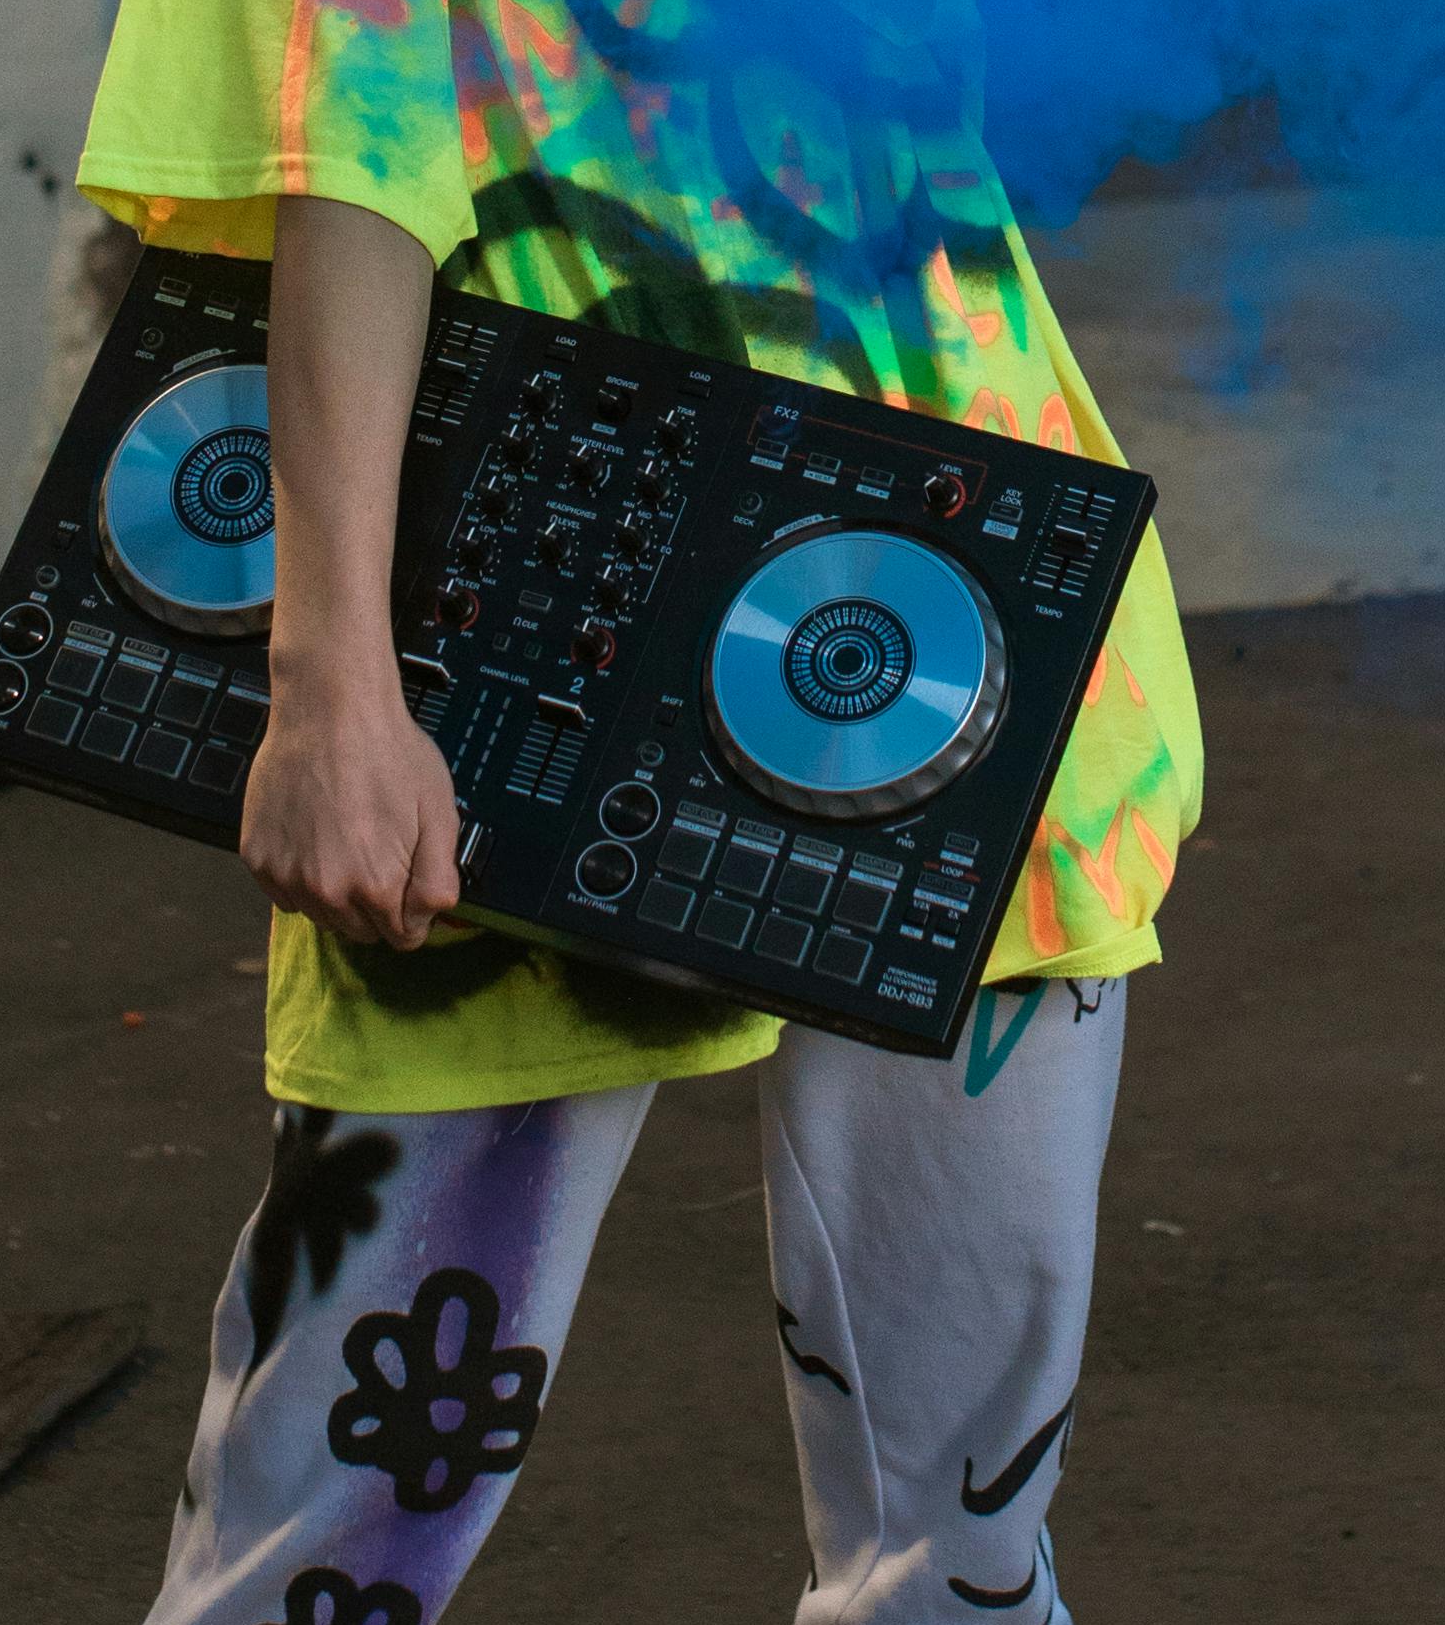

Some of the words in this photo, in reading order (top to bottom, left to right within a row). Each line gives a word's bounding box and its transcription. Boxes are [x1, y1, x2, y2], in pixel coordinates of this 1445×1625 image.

[555, 335, 577, 347] LOAD
[135, 349, 155, 361] DECK
[543, 370, 562, 381] TRIM
[689, 370, 711, 382] LOAD
[605, 376, 640, 391] BROWSE
[677, 405, 697, 417] TRIM
[773, 405, 800, 421] FX2
[415, 432, 443, 447] TEMPO
[571, 435, 601, 450] MASTER
[602, 443, 625, 456] LEVEL
[940, 463, 964, 476] LEVEL
[502, 473, 518, 483] MID
[462, 491, 474, 500] EQ
[1005, 488, 1023, 498] KEY
[1000, 495, 1022, 506] LOCK
[546, 500, 598, 520] HEADPHONES
[637, 510, 653, 520] MID
[58, 520, 81, 533] SHIFT
[558, 518, 581, 530] LEVEL
[733, 515, 754, 527] DECK
[479, 525, 498, 535] LOW
[660, 545, 672, 555] EQ
[615, 562, 634, 572] LOW
[455, 577, 481, 591] FILTER
[81, 598, 98, 609] REV
[1035, 604, 1063, 619] TEMPO
[521, 620, 540, 631] CUE
[590, 615, 616, 629] FILTER
[437, 638, 446, 654] 1
[480, 665, 509, 680] CHANNEL
[510, 674, 530, 686] LEVEL
[569, 676, 585, 695] 2
[661, 695, 684, 707] SHIFT
[689, 777, 706, 788] REV
[896, 837, 915, 849] FWD
[941, 865, 964, 878] LOOP
[567, 892, 619, 915] PLAY/PAUSE
[947, 909, 959, 920] 2X
[878, 982, 933, 1009] DDJ-SB3
